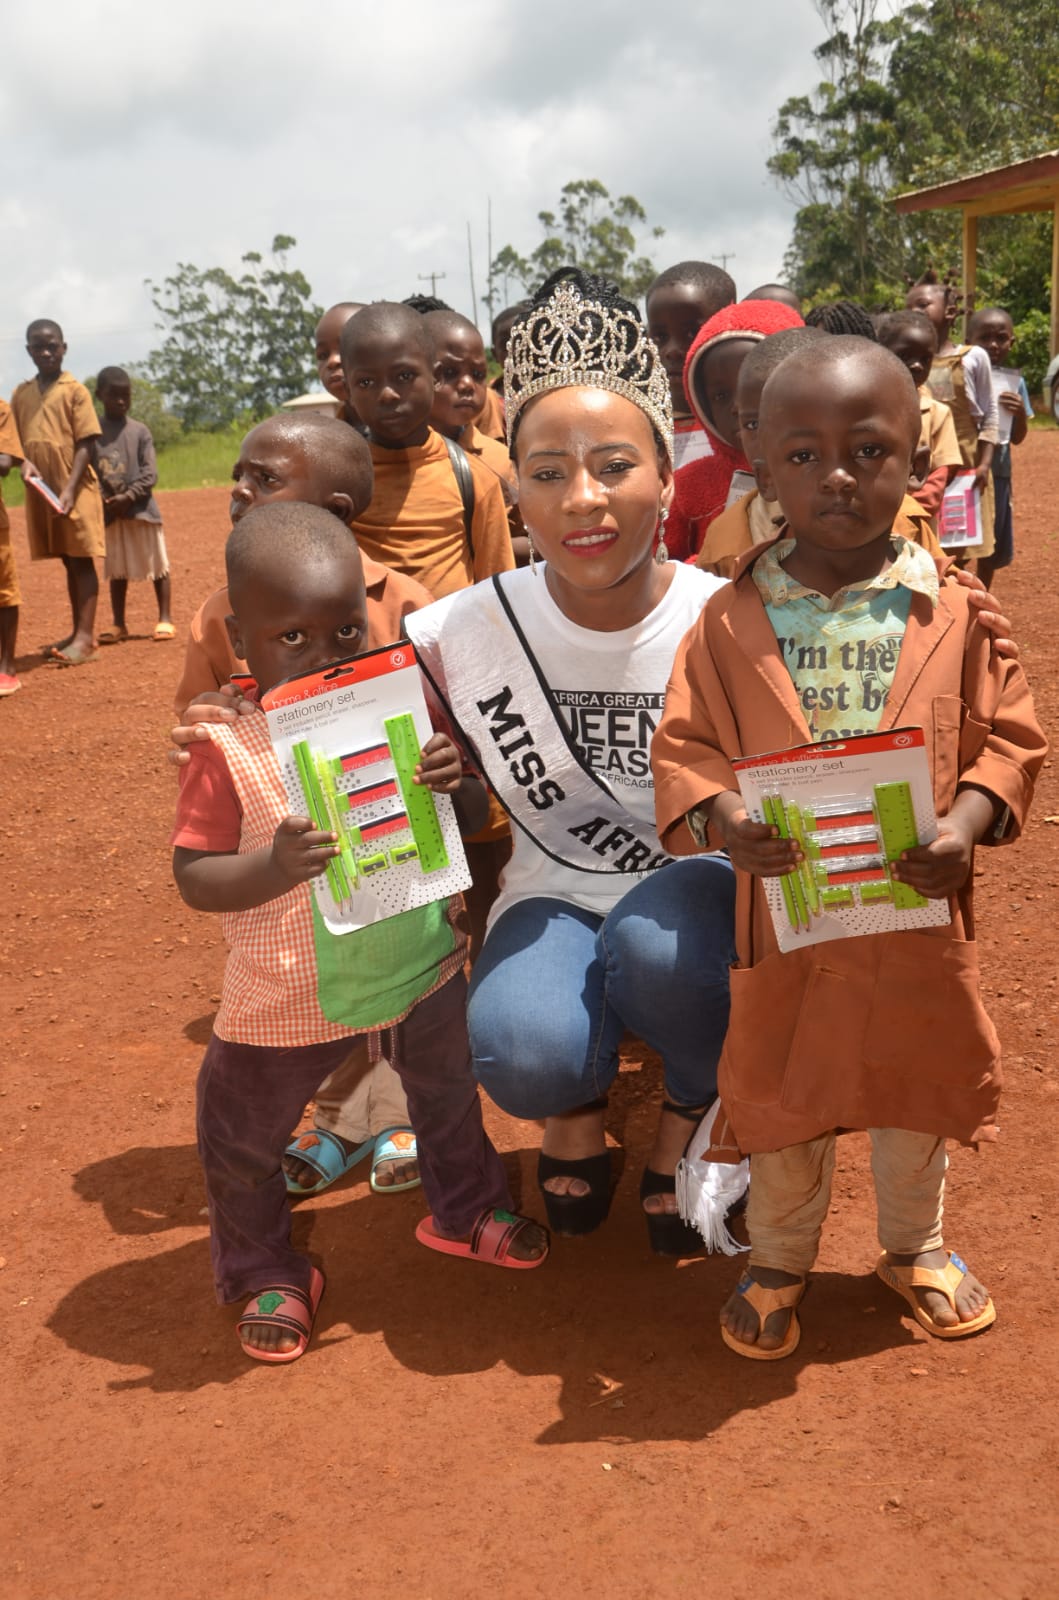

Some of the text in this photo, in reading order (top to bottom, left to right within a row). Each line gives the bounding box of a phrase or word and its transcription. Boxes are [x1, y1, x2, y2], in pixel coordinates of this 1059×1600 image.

[840, 640, 895, 673] the
[276, 698, 334, 724] stationery
[337, 690, 356, 705] set
[603, 695, 655, 707] GREAT
[794, 681, 850, 711] est
[576, 745, 654, 777] EAS
[747, 764, 818, 779] stationery
[822, 760, 845, 771] set
[476, 685, 677, 871] MISS AFRI
